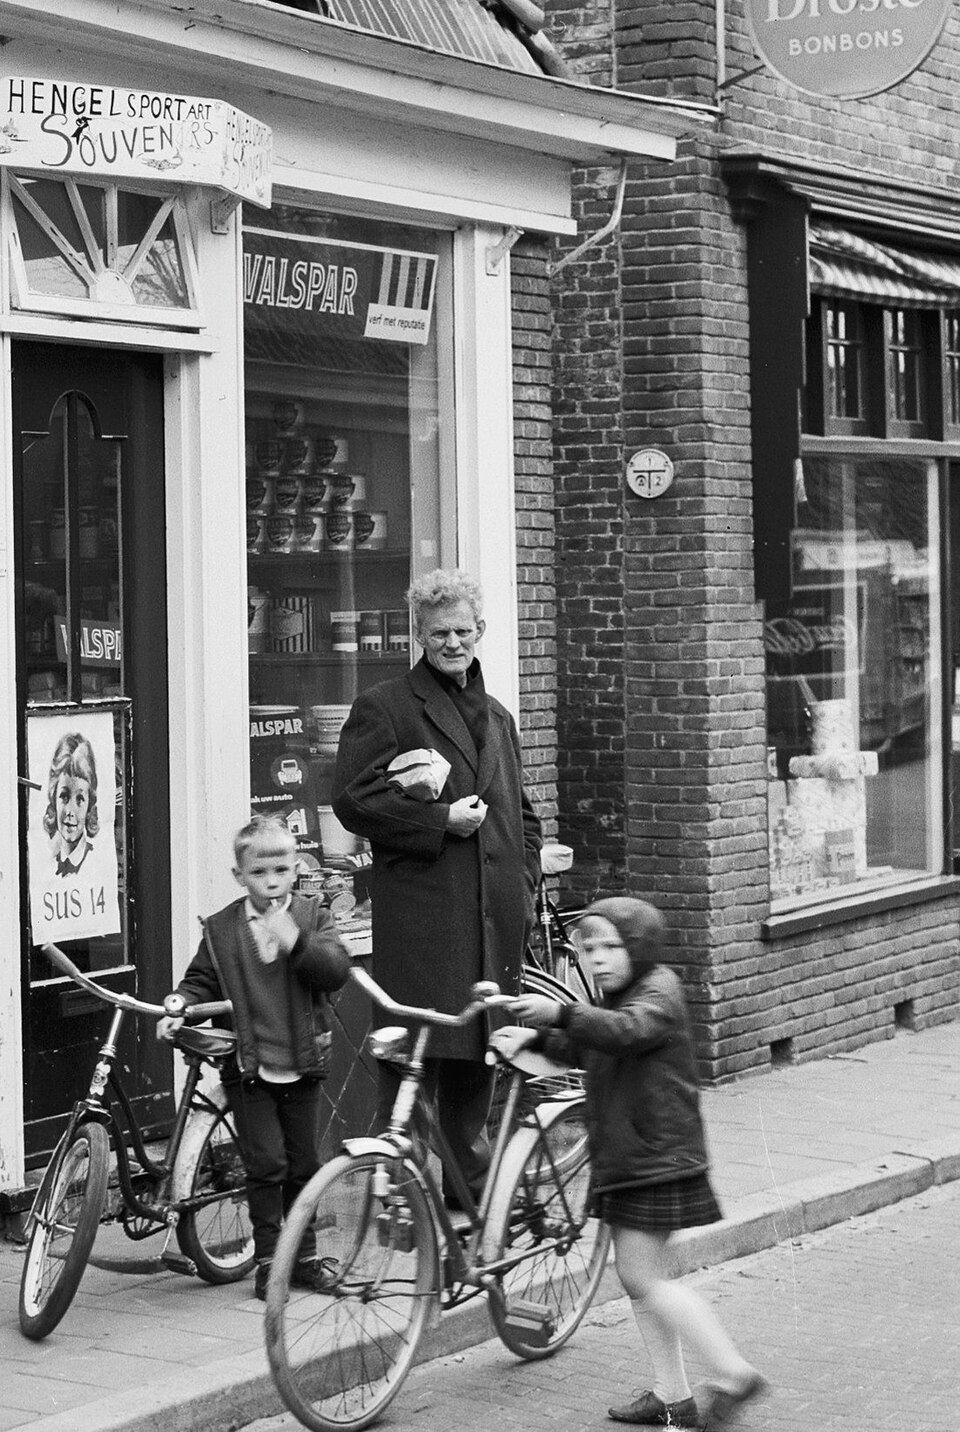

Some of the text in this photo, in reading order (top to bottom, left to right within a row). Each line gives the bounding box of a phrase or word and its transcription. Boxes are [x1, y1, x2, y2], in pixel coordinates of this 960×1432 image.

[788, 28, 905, 56] BONBONS
[243, 252, 358, 316] VALSPAR
[250, 718, 304, 737] ALSPAR
[90, 885, 105, 915] 14
